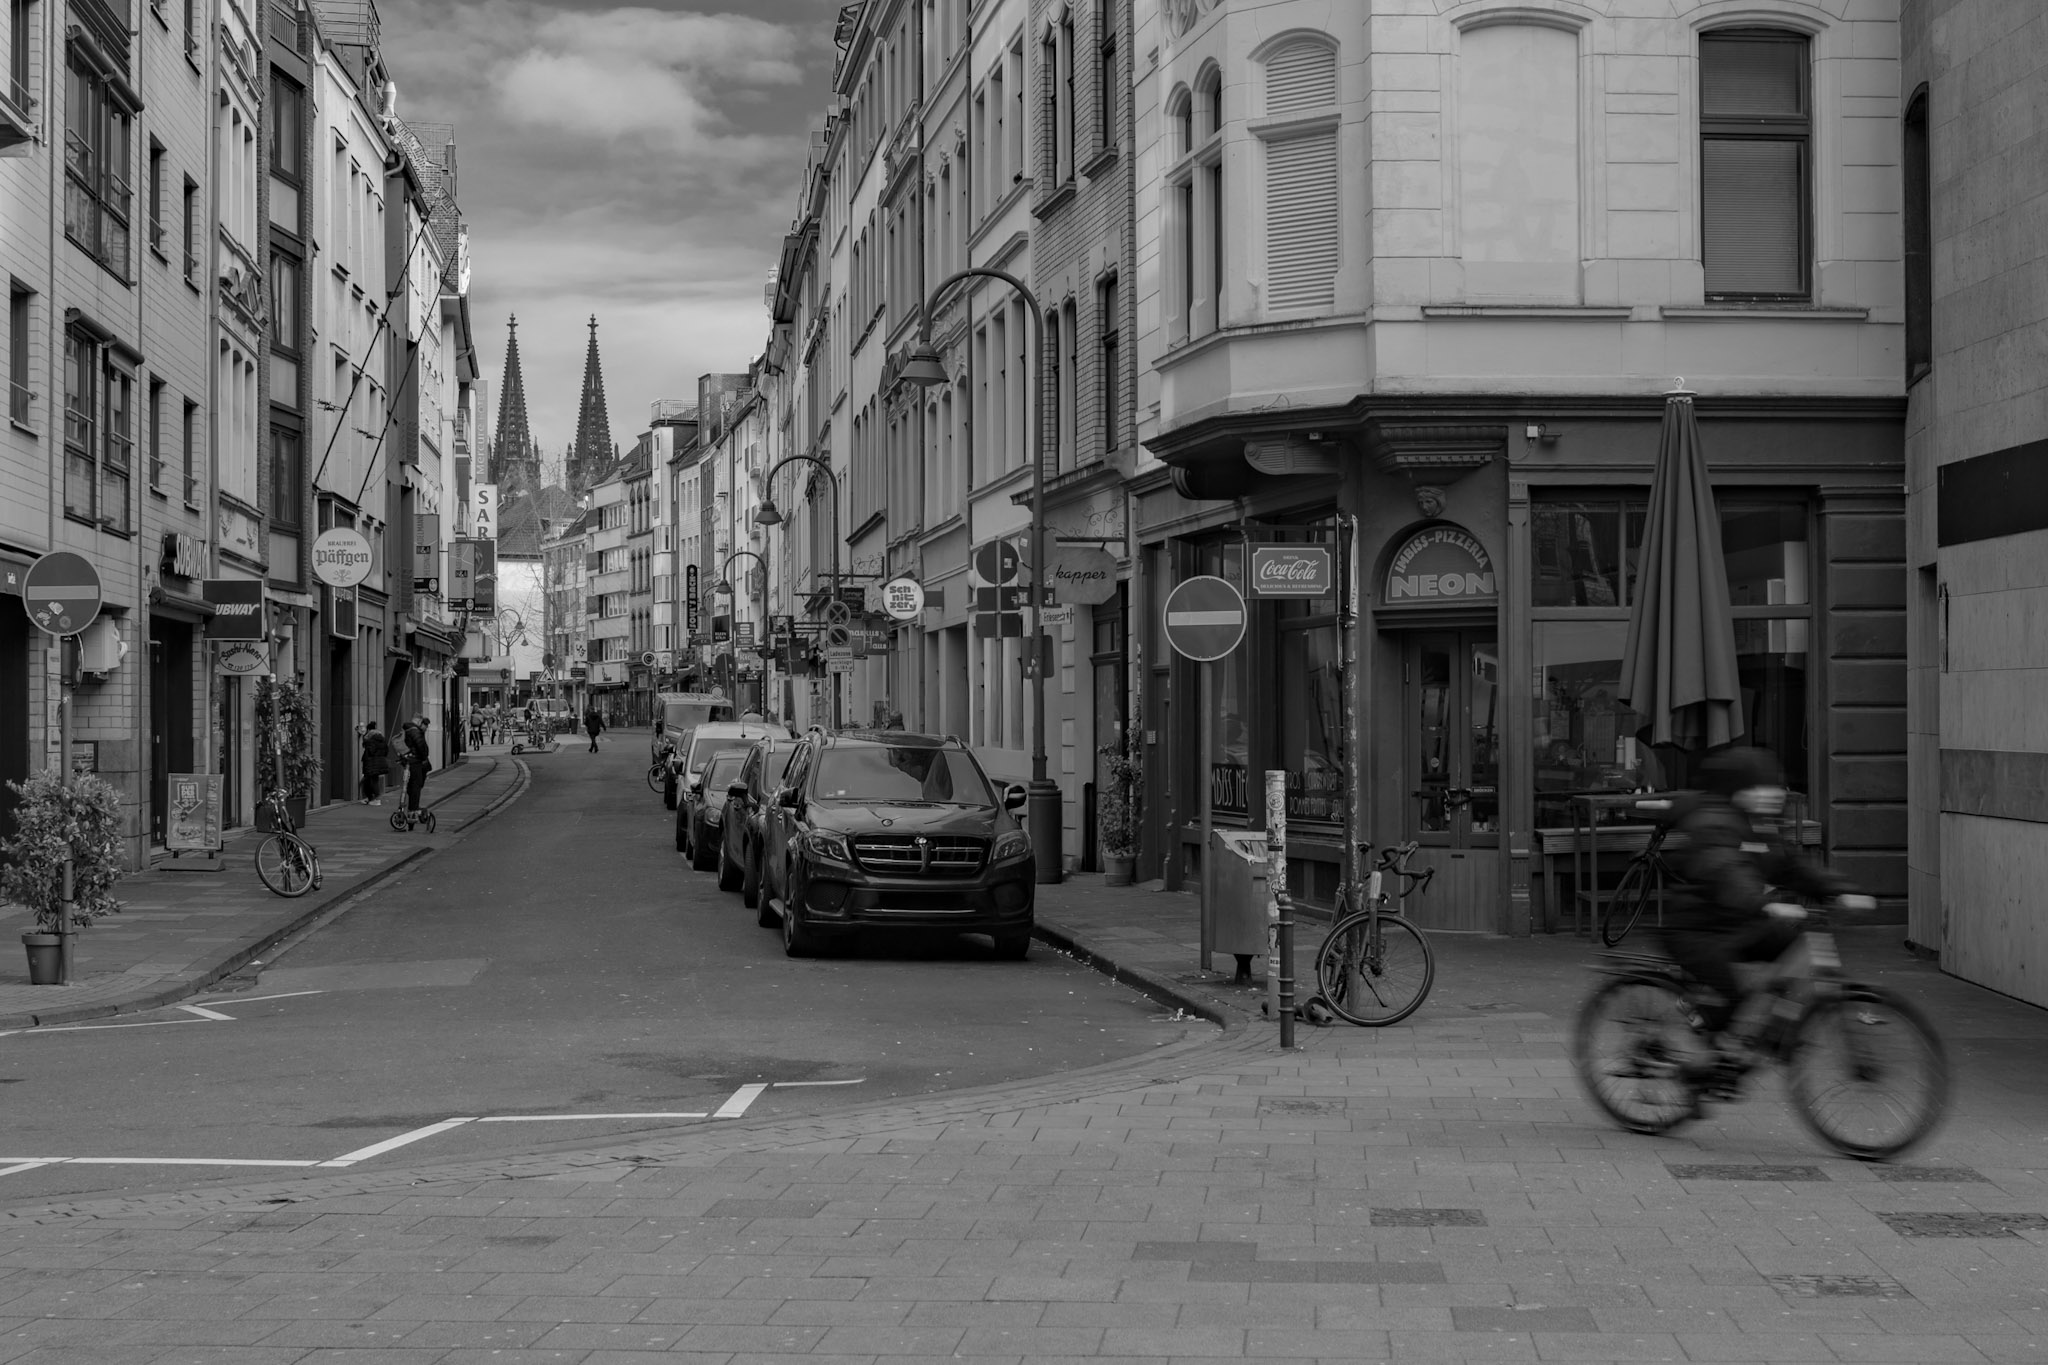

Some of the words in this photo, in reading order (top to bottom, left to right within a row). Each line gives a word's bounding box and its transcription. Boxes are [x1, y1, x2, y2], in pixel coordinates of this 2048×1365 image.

[476, 423, 486, 475] Mercure
[174, 533, 208, 580] SUBWAY
[316, 549, 370, 567] Päffgen
[1395, 530, 1488, 574] IMBISS-PIZZERIA
[1260, 559, 1320, 580] Coca-Cola
[1391, 572, 1494, 598] NEON
[215, 603, 260, 616] UBWAY
